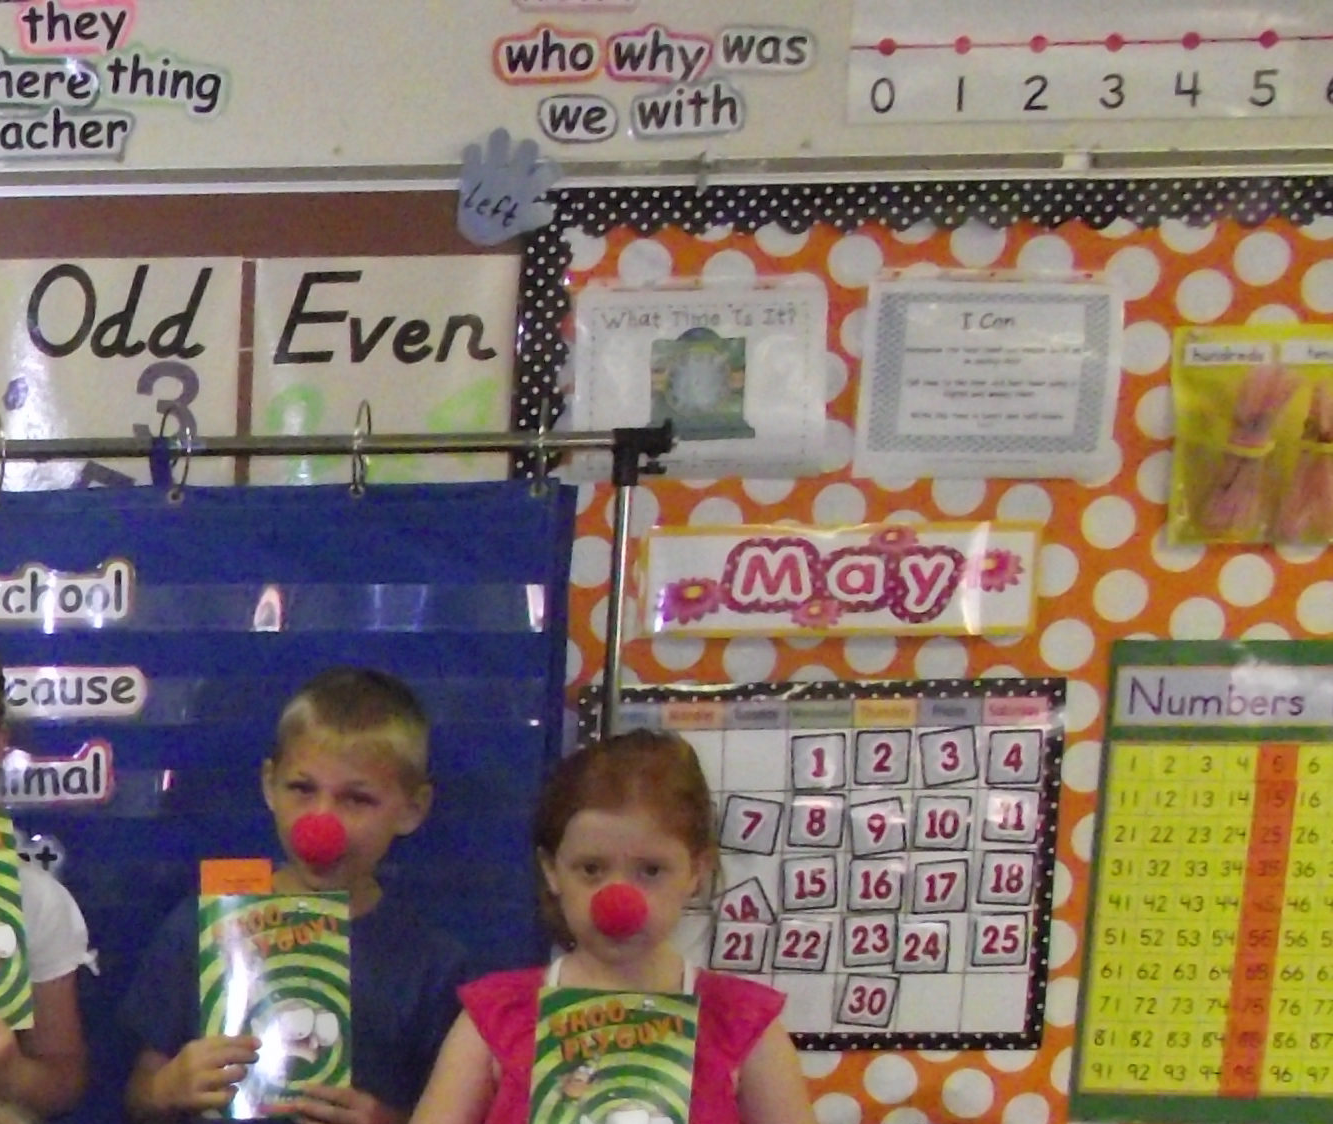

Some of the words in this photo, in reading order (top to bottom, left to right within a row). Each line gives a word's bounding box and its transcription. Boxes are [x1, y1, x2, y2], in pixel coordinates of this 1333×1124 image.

[22, 0, 127, 51] they
[506, 31, 594, 73] who
[614, 30, 705, 81] why
[722, 33, 808, 67] was
[108, 58, 222, 114] thing
[870, 76, 896, 114] 0
[957, 75, 966, 112] 1
[1023, 75, 1049, 111] 2
[1099, 73, 1126, 109] 3
[1174, 71, 1203, 108] 4
[1248, 69, 1279, 108] 5
[548, 106, 607, 135] we
[637, 84, 738, 130] with
[28, 263, 213, 359] Odd
[273, 270, 498, 365] Even
[601, 310, 661, 331] What
[671, 308, 721, 330] Time
[731, 309, 753, 329] Is
[762, 306, 798, 328] It?
[961, 311, 973, 331] I
[979, 312, 1017, 331] Can
[134, 361, 200, 442] 3
[740, 551, 953, 610] May
[1127, 676, 1306, 717] Numbers
[811, 747, 825, 777] 1
[872, 742, 893, 773] 2
[939, 741, 959, 771] 3
[1002, 743, 1024, 773] 4
[1163, 755, 1175, 774] 2
[1201, 755, 1212, 773] 3
[1236, 755, 1248, 771] 4
[1308, 756, 1320, 774] 6
[741, 810, 764, 841] 7
[805, 807, 827, 837] 8
[866, 813, 887, 844] 9
[924, 809, 960, 840] 10
[999, 801, 1025, 831] 11
[1114, 825, 1136, 843] 21
[1149, 825, 1174, 844] 22
[1186, 825, 1212, 844] 23
[1222, 825, 1246, 844] 24
[793, 868, 827, 900] 15
[859, 869, 893, 900] 16
[924, 871, 958, 903] 17
[990, 863, 1025, 894] 18
[722, 931, 755, 961] 21
[781, 929, 821, 959] 22
[851, 923, 890, 955] 23
[902, 931, 941, 962] 24
[981, 924, 1019, 954] 25
[847, 985, 887, 1016] 30
